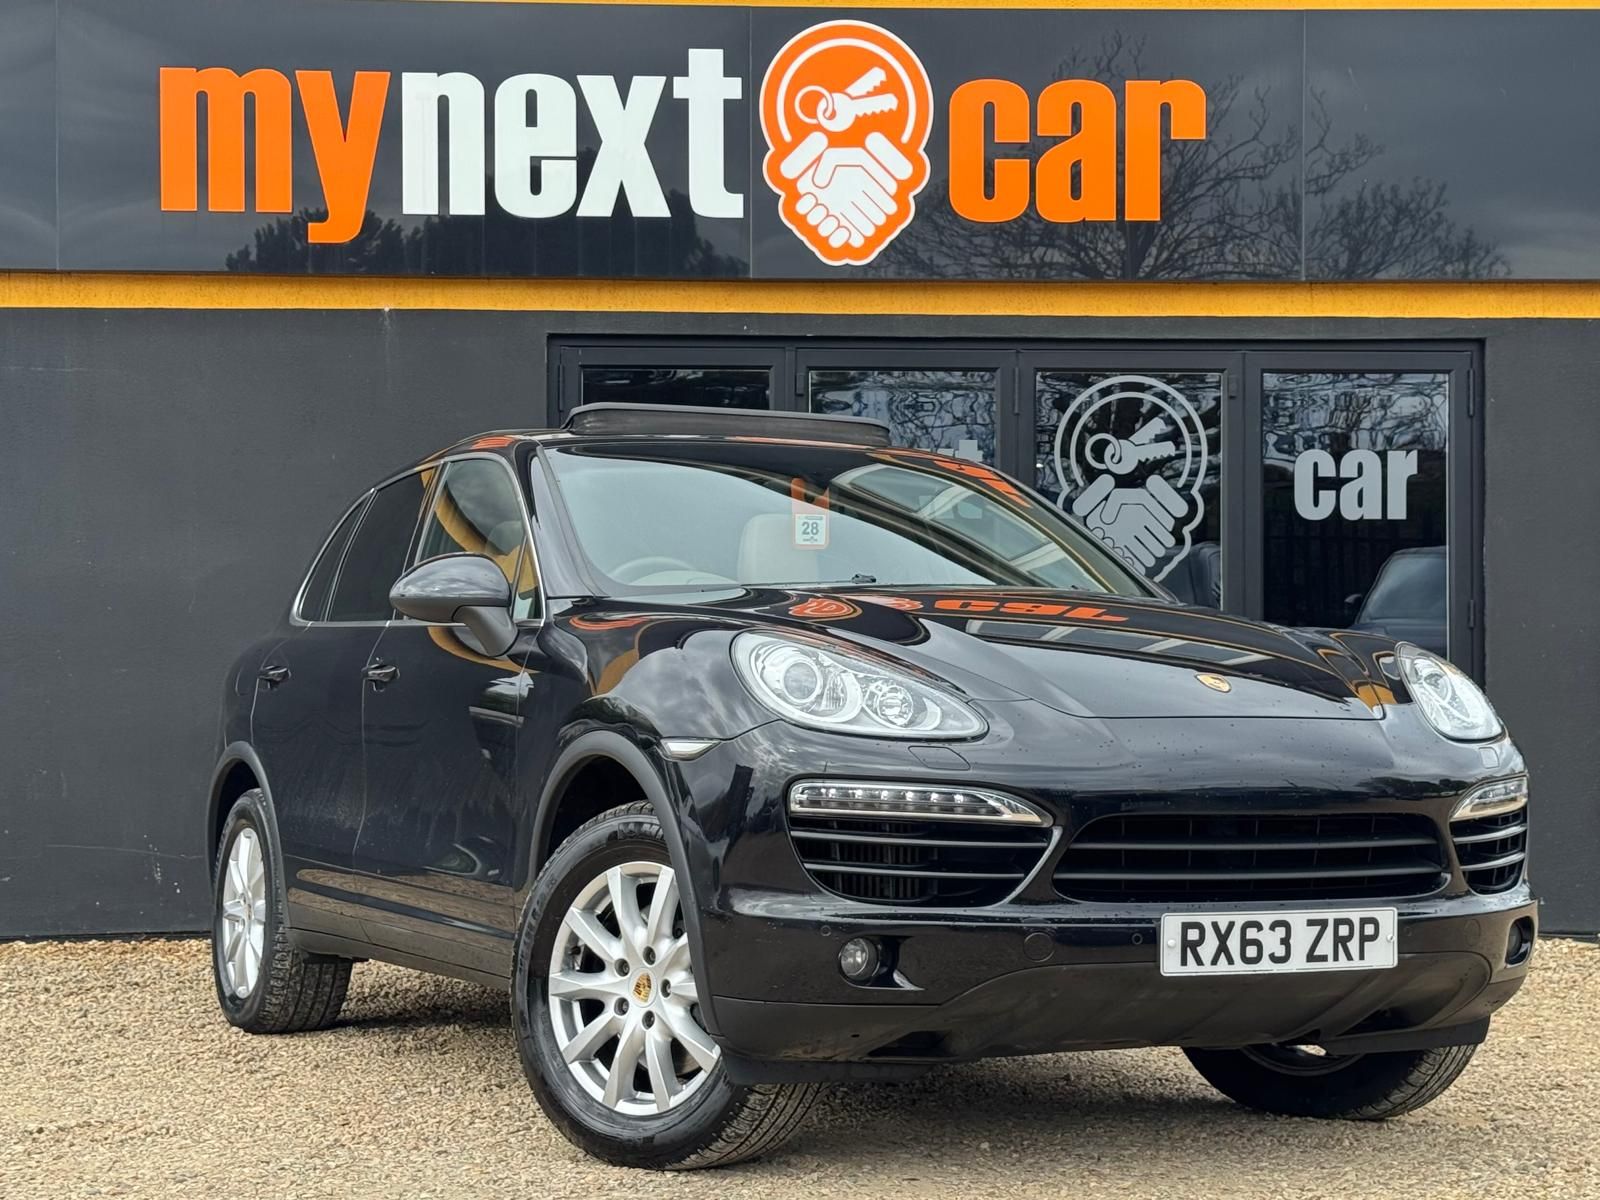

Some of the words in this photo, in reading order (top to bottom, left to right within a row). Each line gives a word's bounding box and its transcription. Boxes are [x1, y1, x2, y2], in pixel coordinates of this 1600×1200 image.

[949, 79, 1207, 223] car
[1294, 449, 1418, 521] car
[801, 521, 819, 535] 28
[1180, 919, 1292, 967] RX63
[1305, 916, 1380, 963] ZRP
